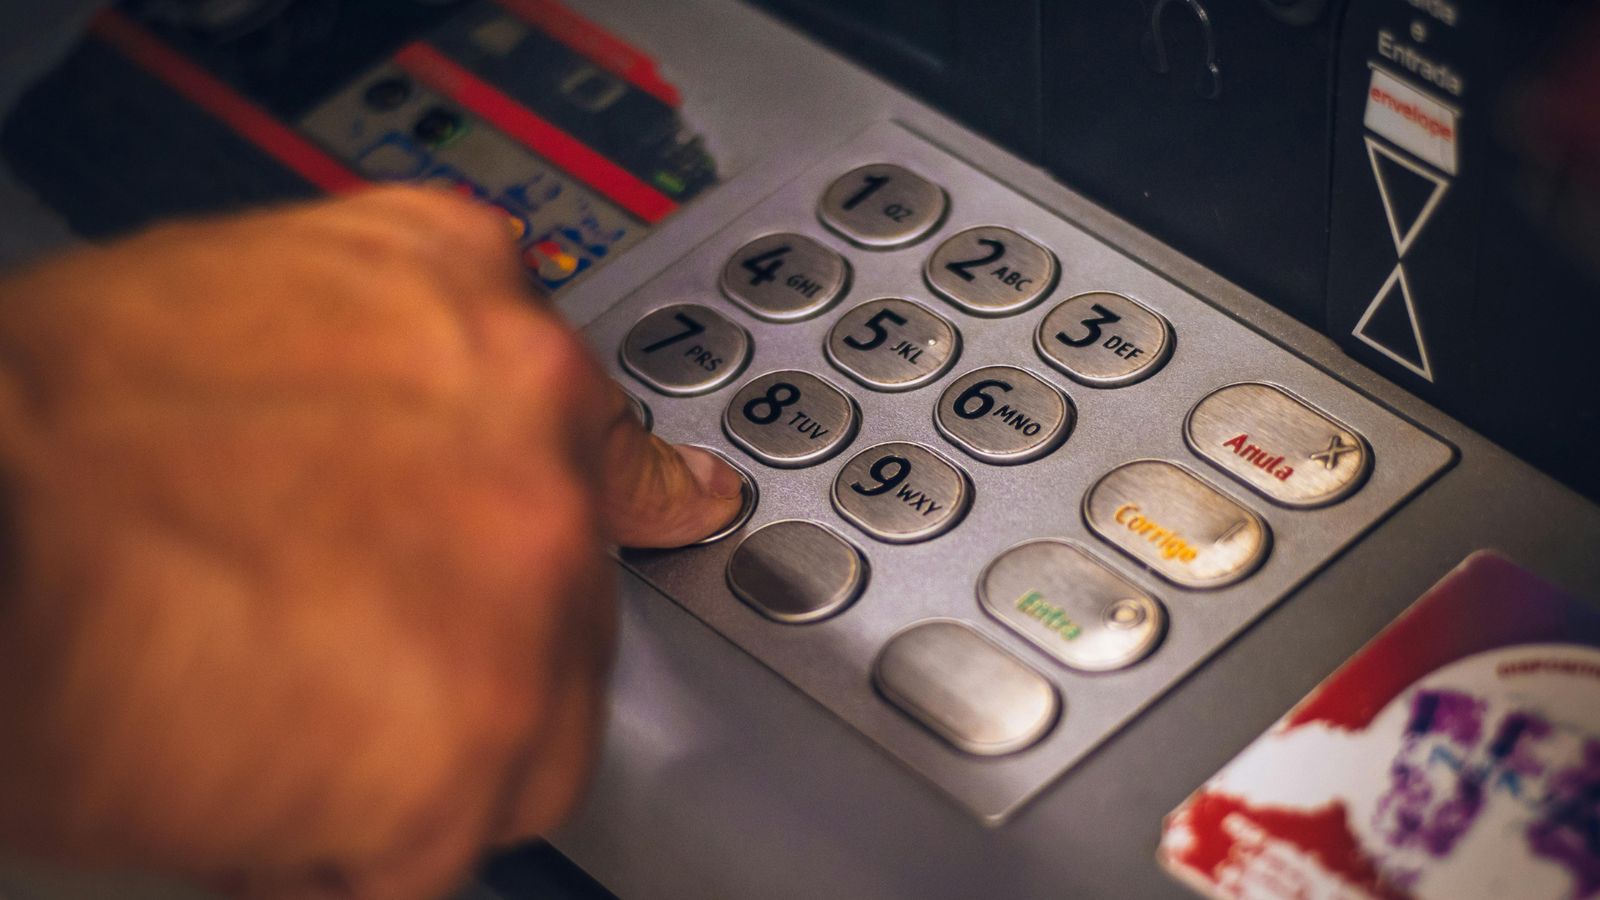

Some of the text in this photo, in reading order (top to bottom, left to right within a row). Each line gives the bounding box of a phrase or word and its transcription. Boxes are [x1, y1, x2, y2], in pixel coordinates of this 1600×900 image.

[1378, 29, 1462, 95] Entrada
[1369, 87, 1454, 143] envelope
[842, 174, 891, 211] 1
[741, 246, 823, 299] 4 GHI
[945, 238, 1034, 292] 2 ABC
[640, 312, 723, 373] 7 PRS
[842, 308, 924, 365] 5 JKL
[1055, 303, 1145, 361] 3 DEF
[742, 382, 830, 441] 8 TUV
[952, 379, 1042, 437] 6 MNO
[850, 454, 943, 517] 9 WXY
[1222, 433, 1295, 482] Anula
[1113, 503, 1198, 563] Corrige
